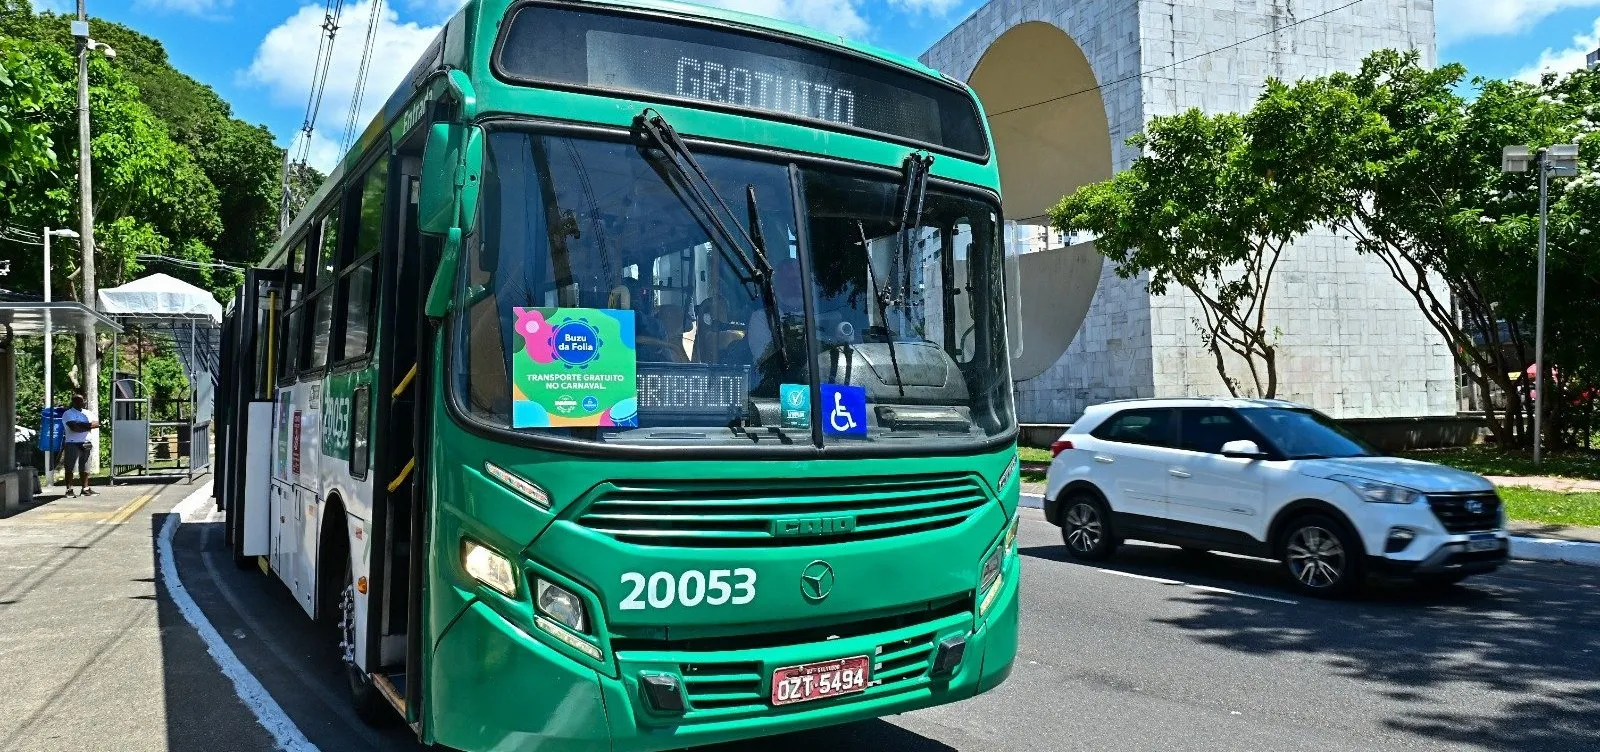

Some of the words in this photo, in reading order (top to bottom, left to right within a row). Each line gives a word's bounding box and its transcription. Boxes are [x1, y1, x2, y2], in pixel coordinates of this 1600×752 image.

[676, 56, 854, 126] GRATUITO
[564, 333, 587, 342] Buzu
[558, 342, 570, 351] da
[571, 342, 594, 351] Folia
[526, 373, 582, 382] TRANSPORTE
[583, 373, 625, 382] GRATUITO
[545, 382, 560, 390] NO
[636, 374, 743, 407] ARIBALDI
[619, 567, 757, 611] 20053
